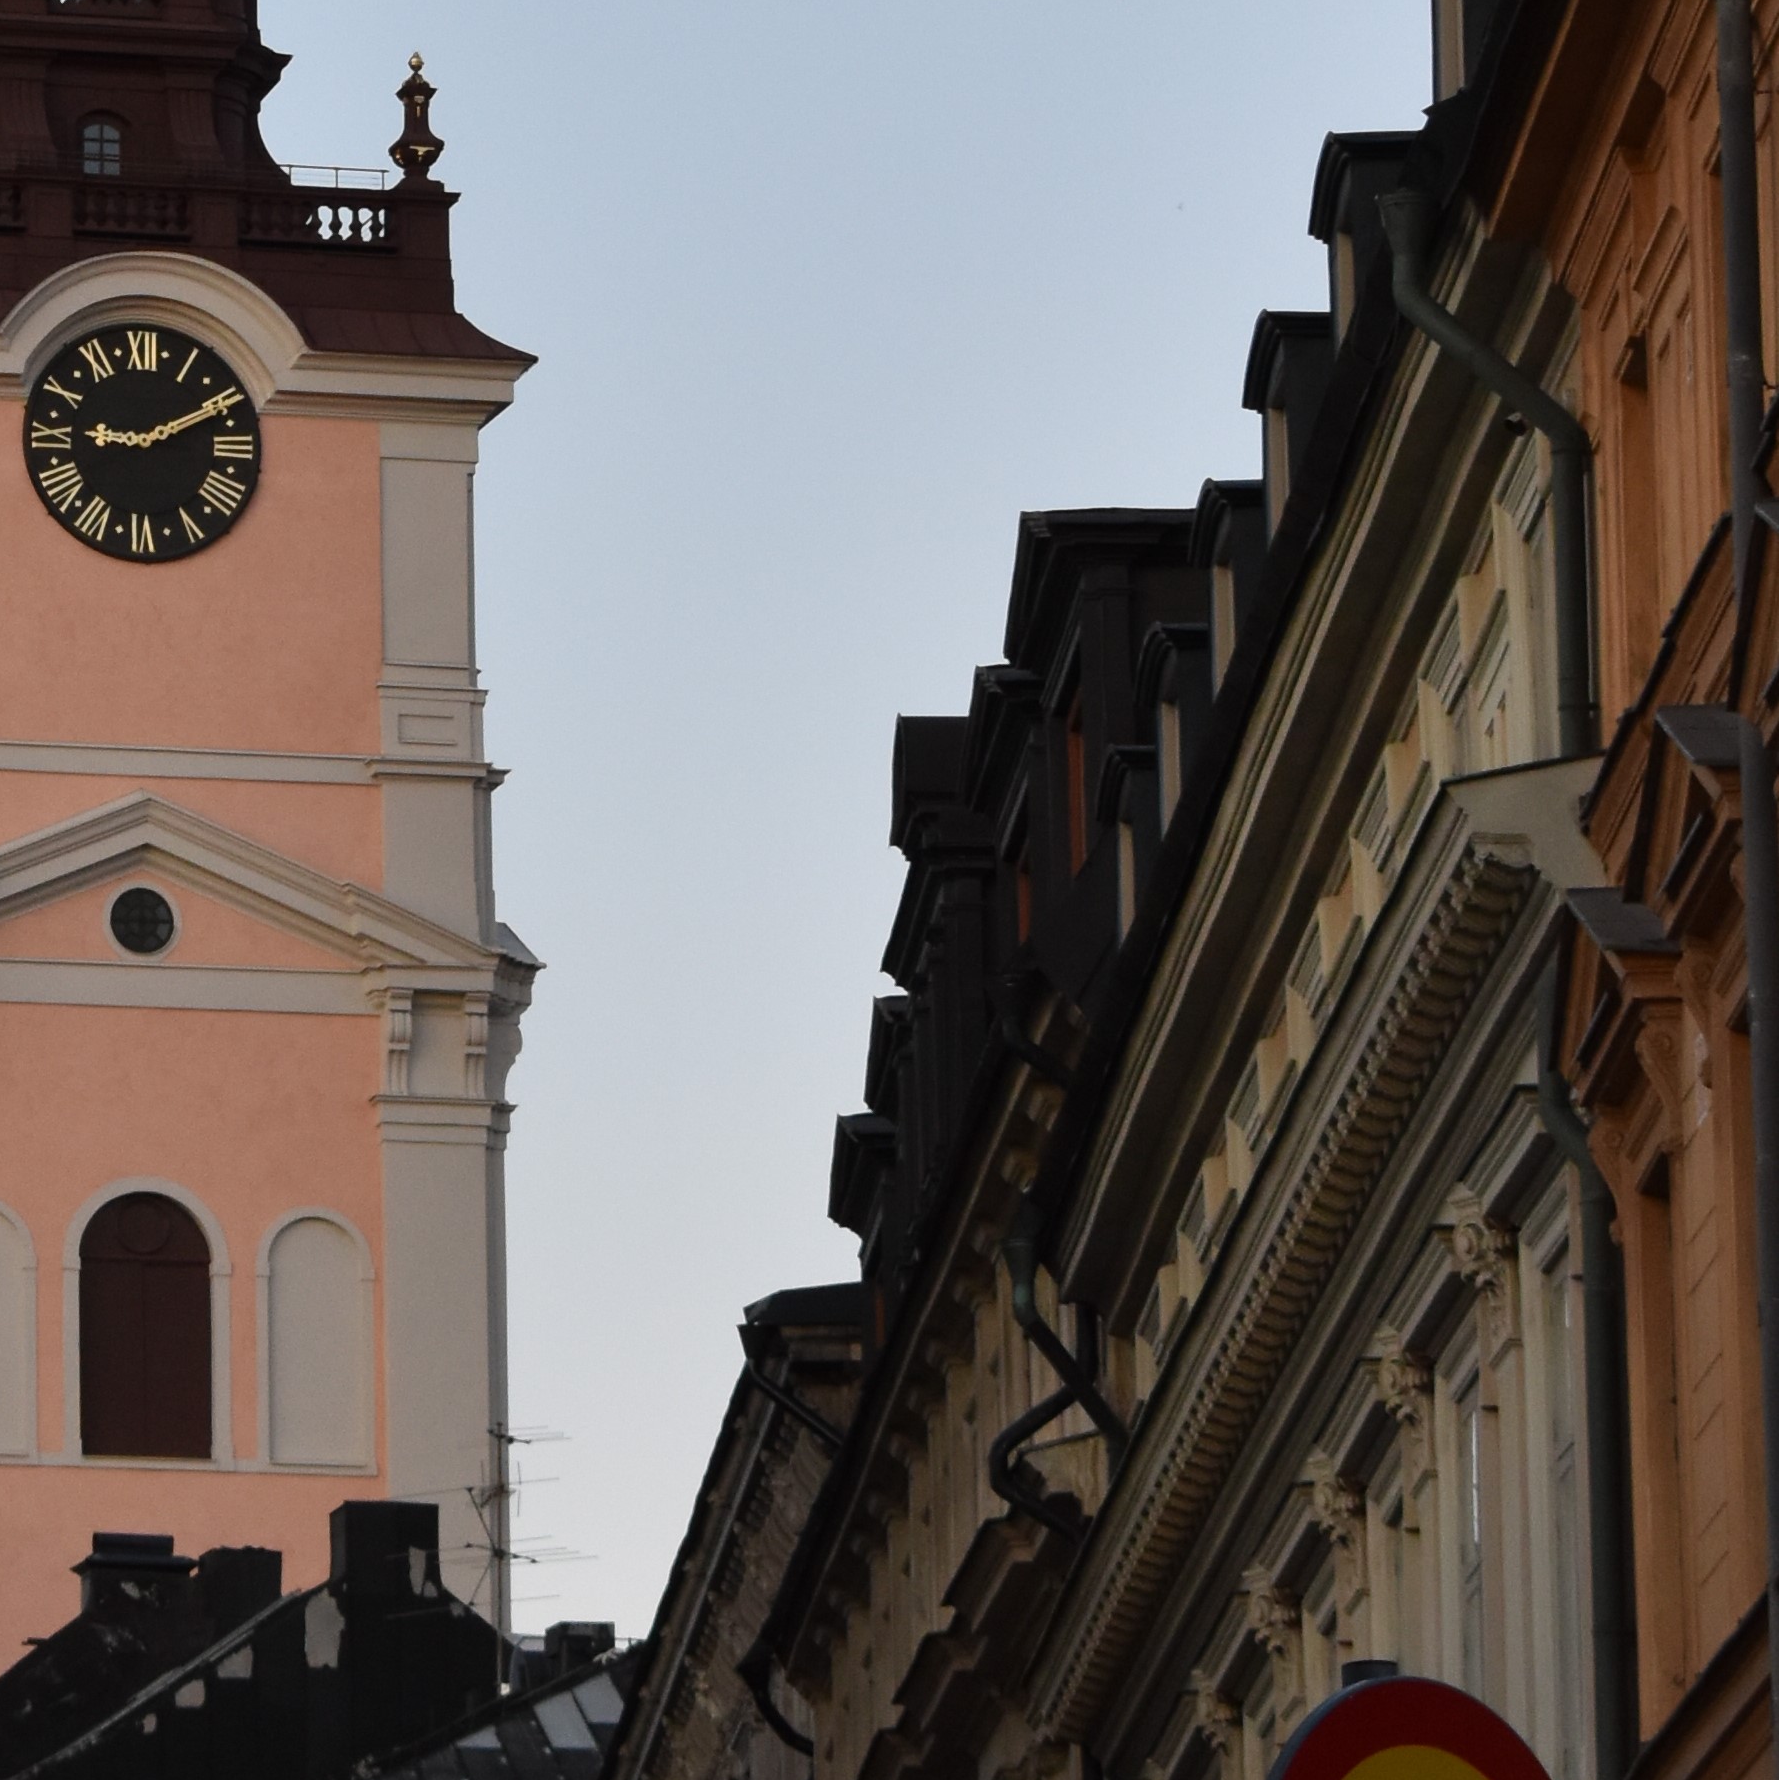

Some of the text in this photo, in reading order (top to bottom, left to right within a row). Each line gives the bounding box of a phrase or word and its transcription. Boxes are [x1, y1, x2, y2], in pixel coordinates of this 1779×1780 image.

[78, 338, 115, 383] XI
[126, 330, 158, 372] XII
[176, 347, 199, 383] I
[43, 375, 83, 409] X
[31, 421, 72, 449] IX
[74, 495, 111, 541] VII
[131, 513, 155, 553] VI
[178, 506, 205, 543] V
